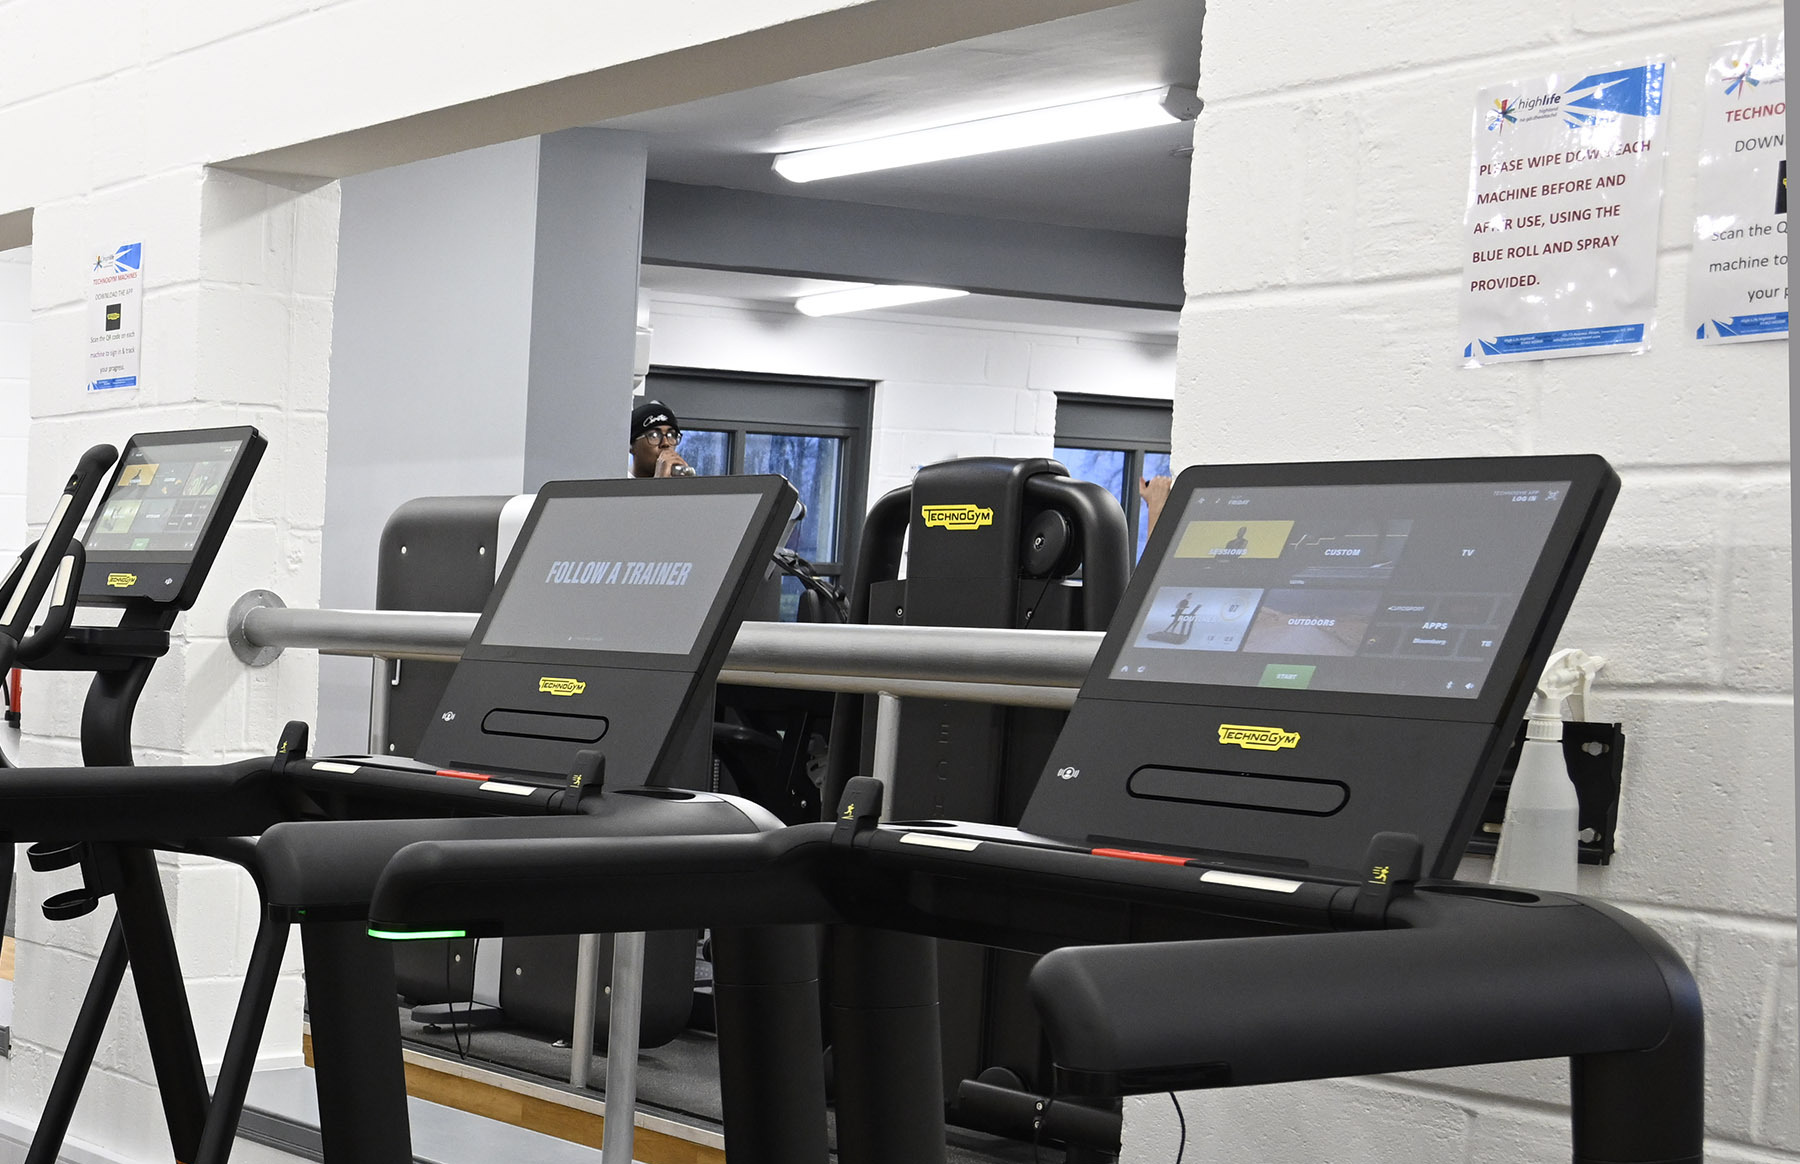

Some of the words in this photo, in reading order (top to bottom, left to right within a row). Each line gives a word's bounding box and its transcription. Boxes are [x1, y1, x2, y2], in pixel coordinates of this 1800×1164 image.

[1518, 93, 1561, 110] highlife
[1480, 159, 1523, 175] PLASE
[1527, 153, 1561, 168] WIPE
[1477, 186, 1538, 205] MACHINE
[1541, 178, 1592, 196] BEFORE
[1596, 174, 1626, 188] AND
[1473, 219, 1512, 234] AFR
[1517, 215, 1545, 228] USE,
[1550, 208, 1591, 224] USING
[1596, 205, 1621, 219] THE
[1748, 223, 1772, 237] the
[1472, 248, 1503, 263] BLUE
[1507, 245, 1539, 259] ROLL
[1542, 241, 1573, 254] AND
[1576, 235, 1619, 251] SPRAY
[1709, 256, 1769, 273] machine
[1774, 254, 1788, 266] to
[1470, 274, 1540, 292] PROVIDED.
[1747, 287, 1780, 303] your
[924, 508, 990, 525] TECHNOGYM
[1208, 548, 1248, 556] SESSIONS
[545, 561, 610, 584] FOLLOW
[605, 562, 622, 584] A
[621, 562, 693, 585] TRAINER
[1288, 618, 1335, 627] OUTDOORS
[1422, 622, 1448, 630] APPS
[542, 679, 584, 692] TECHNOGYM
[1222, 727, 1296, 746] TECHNOGYM
